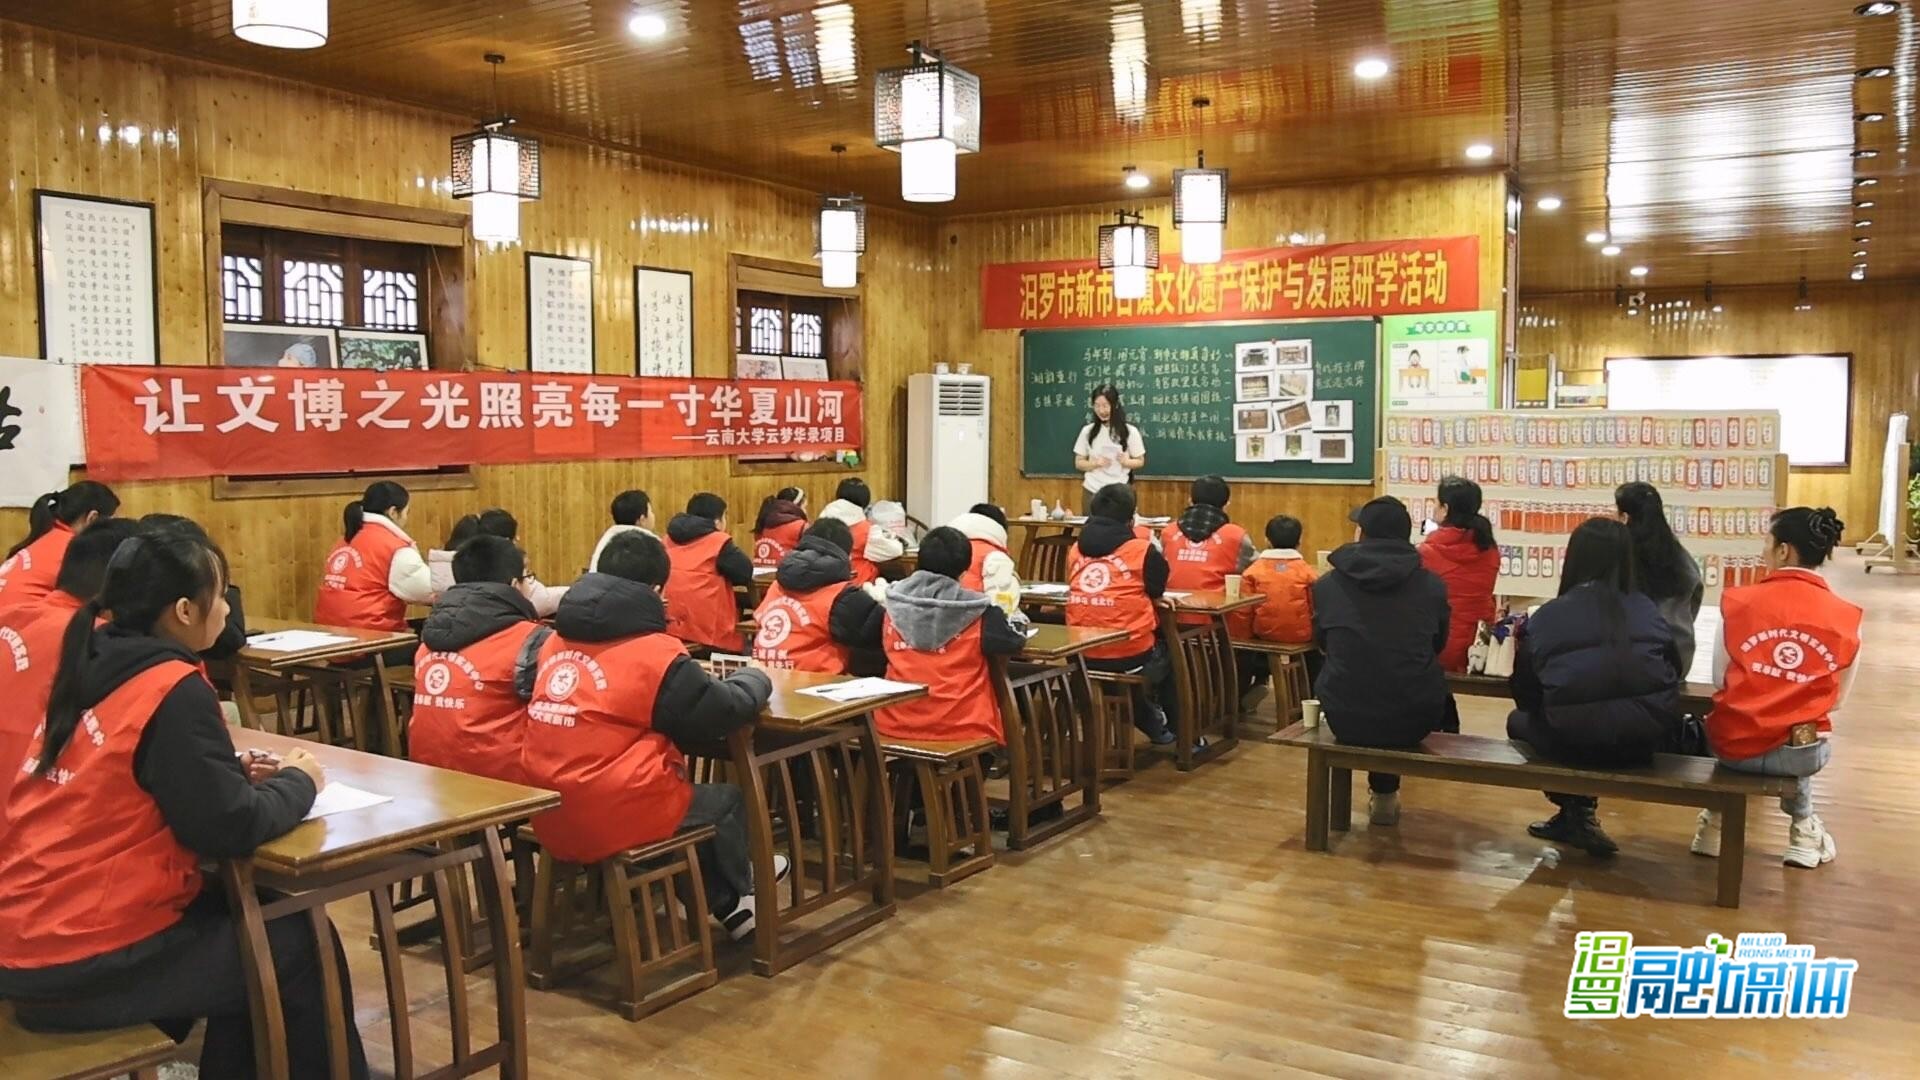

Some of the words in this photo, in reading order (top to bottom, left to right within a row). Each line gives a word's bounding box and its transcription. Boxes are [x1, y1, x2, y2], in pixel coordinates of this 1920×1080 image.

[134, 377, 844, 435] 让文博之光照亮每一寸华夏山河
